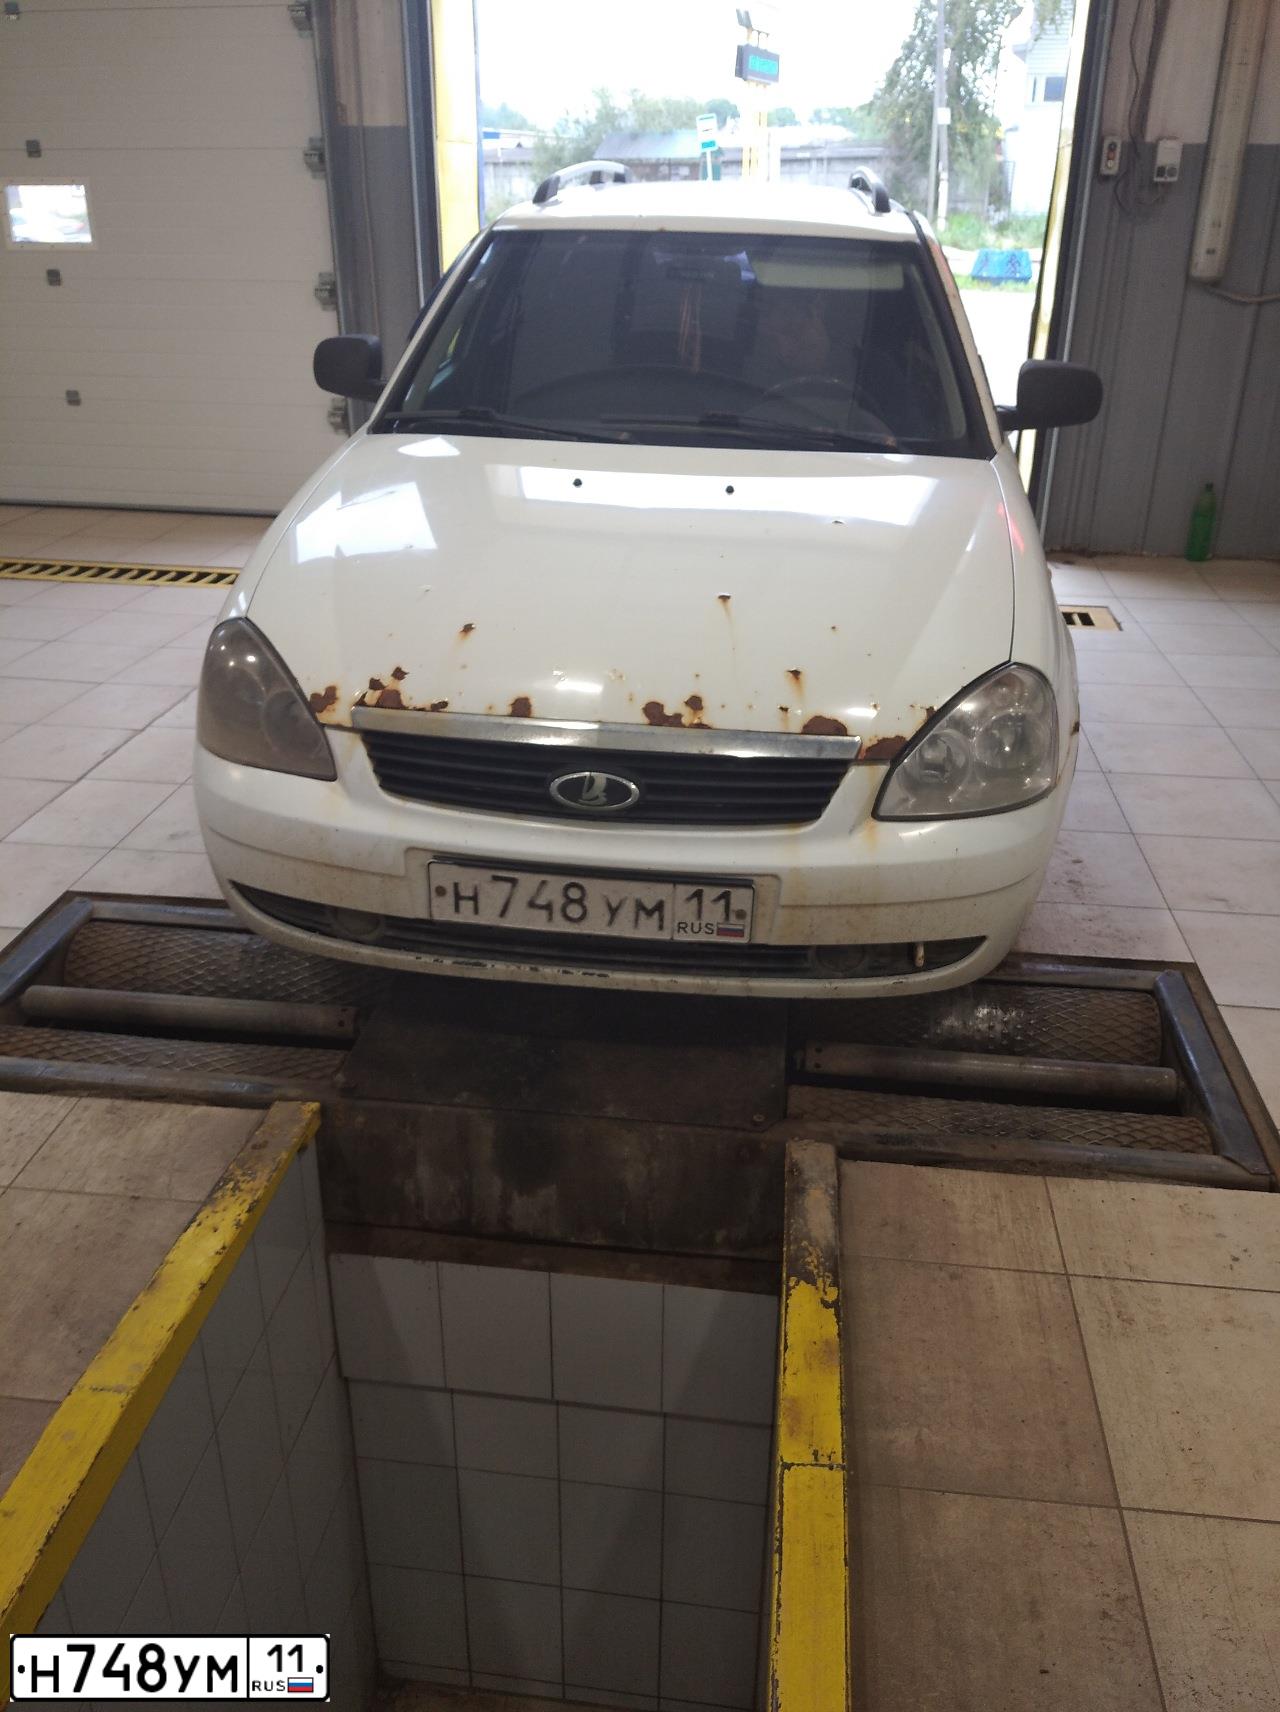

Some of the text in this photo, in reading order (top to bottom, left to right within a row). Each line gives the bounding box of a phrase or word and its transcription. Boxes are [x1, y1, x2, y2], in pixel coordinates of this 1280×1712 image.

[453, 874, 732, 931] Н748УМ 11
[677, 921, 714, 936] RUS
